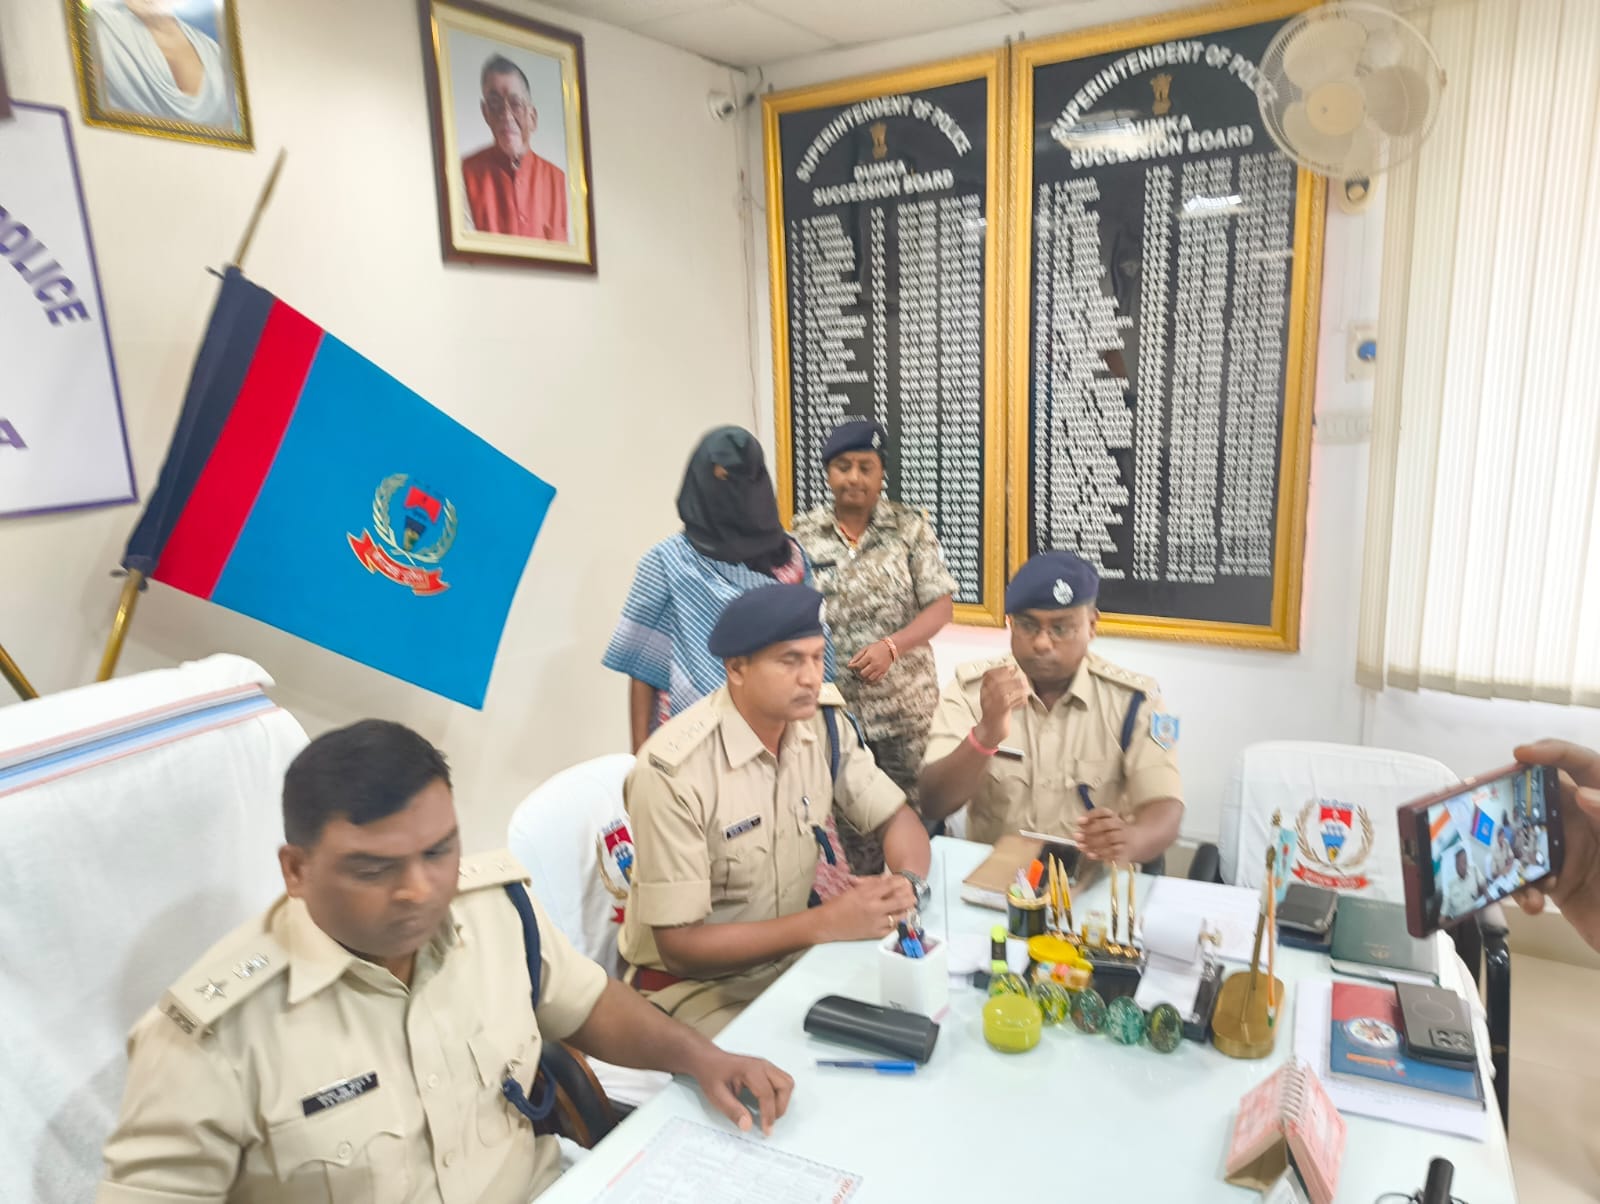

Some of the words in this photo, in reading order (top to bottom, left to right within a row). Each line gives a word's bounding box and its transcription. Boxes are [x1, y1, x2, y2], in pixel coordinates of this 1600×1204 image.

[1205, 43, 1232, 70] OF
[912, 97, 933, 121] OF
[1187, 124, 1254, 153] BOARD
[903, 168, 954, 194] BOARD
